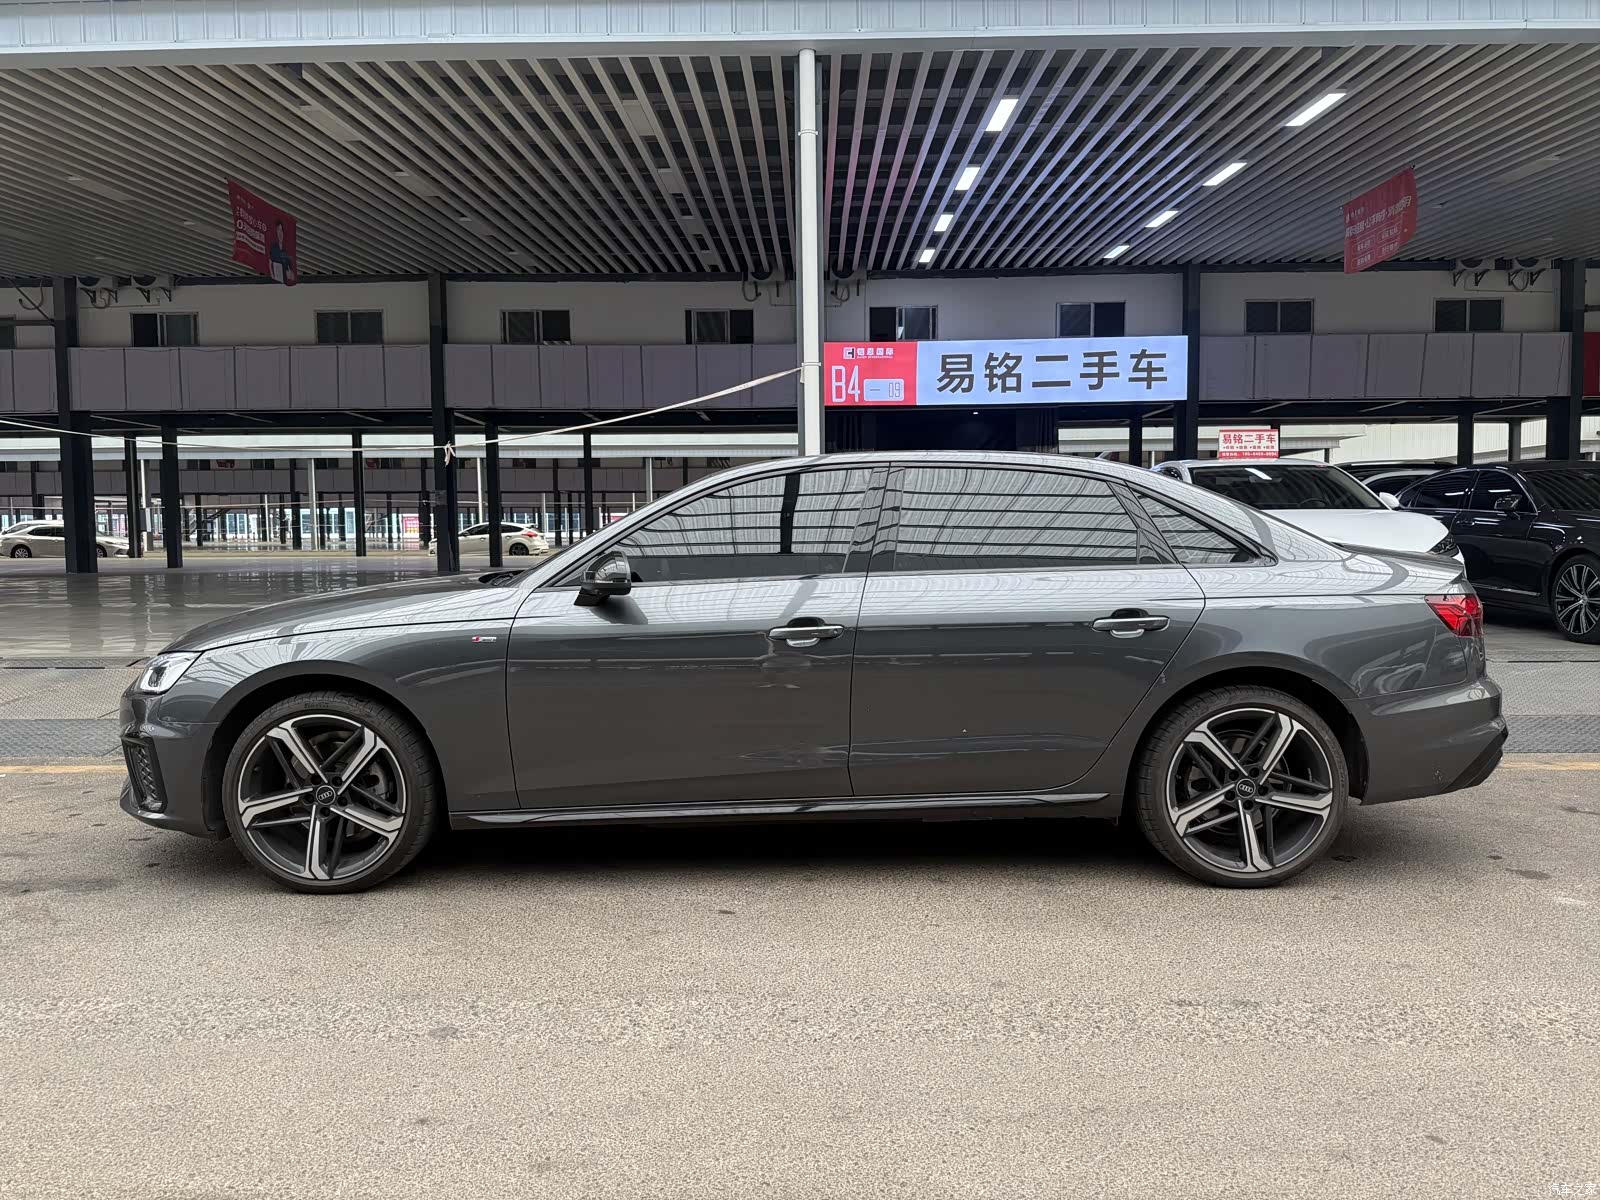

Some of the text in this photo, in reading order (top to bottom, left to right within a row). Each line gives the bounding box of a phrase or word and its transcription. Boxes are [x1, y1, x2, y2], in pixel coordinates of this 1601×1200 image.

[831, 364, 861, 403] B4
[936, 348, 1168, 394] 易铭二手车
[1222, 433, 1276, 444] 易铭二手车
